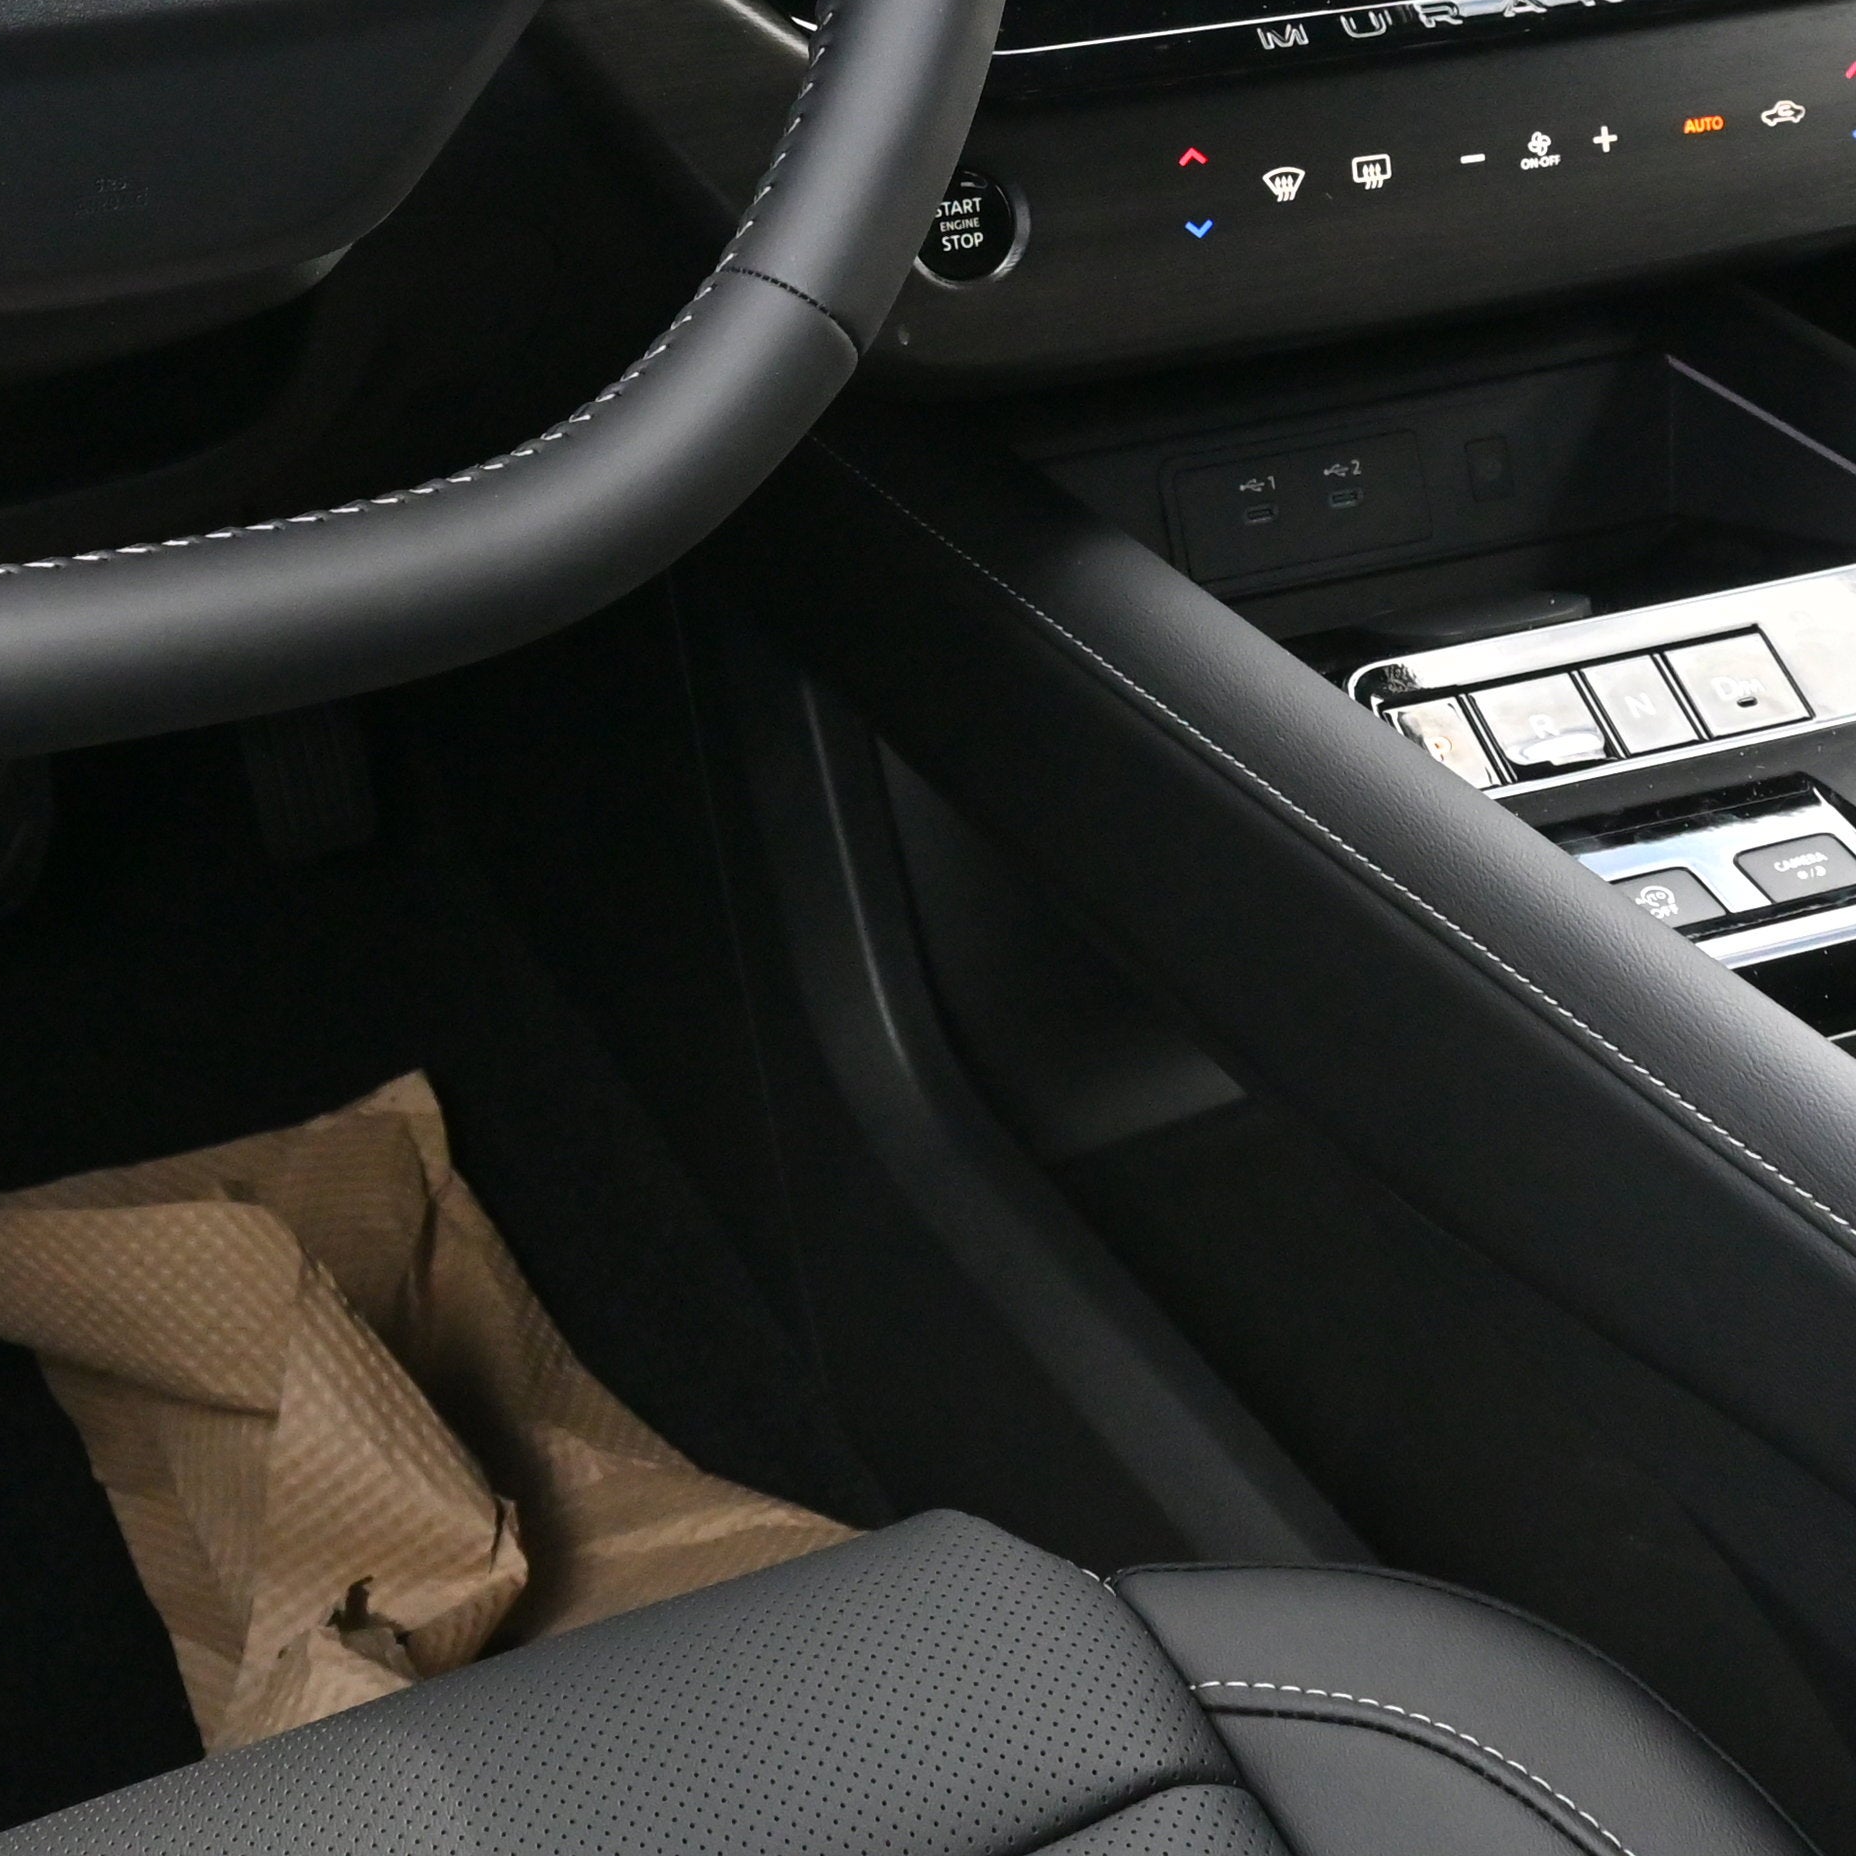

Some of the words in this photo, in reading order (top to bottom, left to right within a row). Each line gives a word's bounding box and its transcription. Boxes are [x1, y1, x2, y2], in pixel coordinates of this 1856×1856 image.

[1683, 115, 1724, 134] AUTO
[939, 217, 980, 232] ENGINE
[941, 232, 984, 251] STOP
[1625, 692, 1657, 719] N
[1529, 714, 1558, 739] R
[1773, 851, 1829, 873] CAMERA
